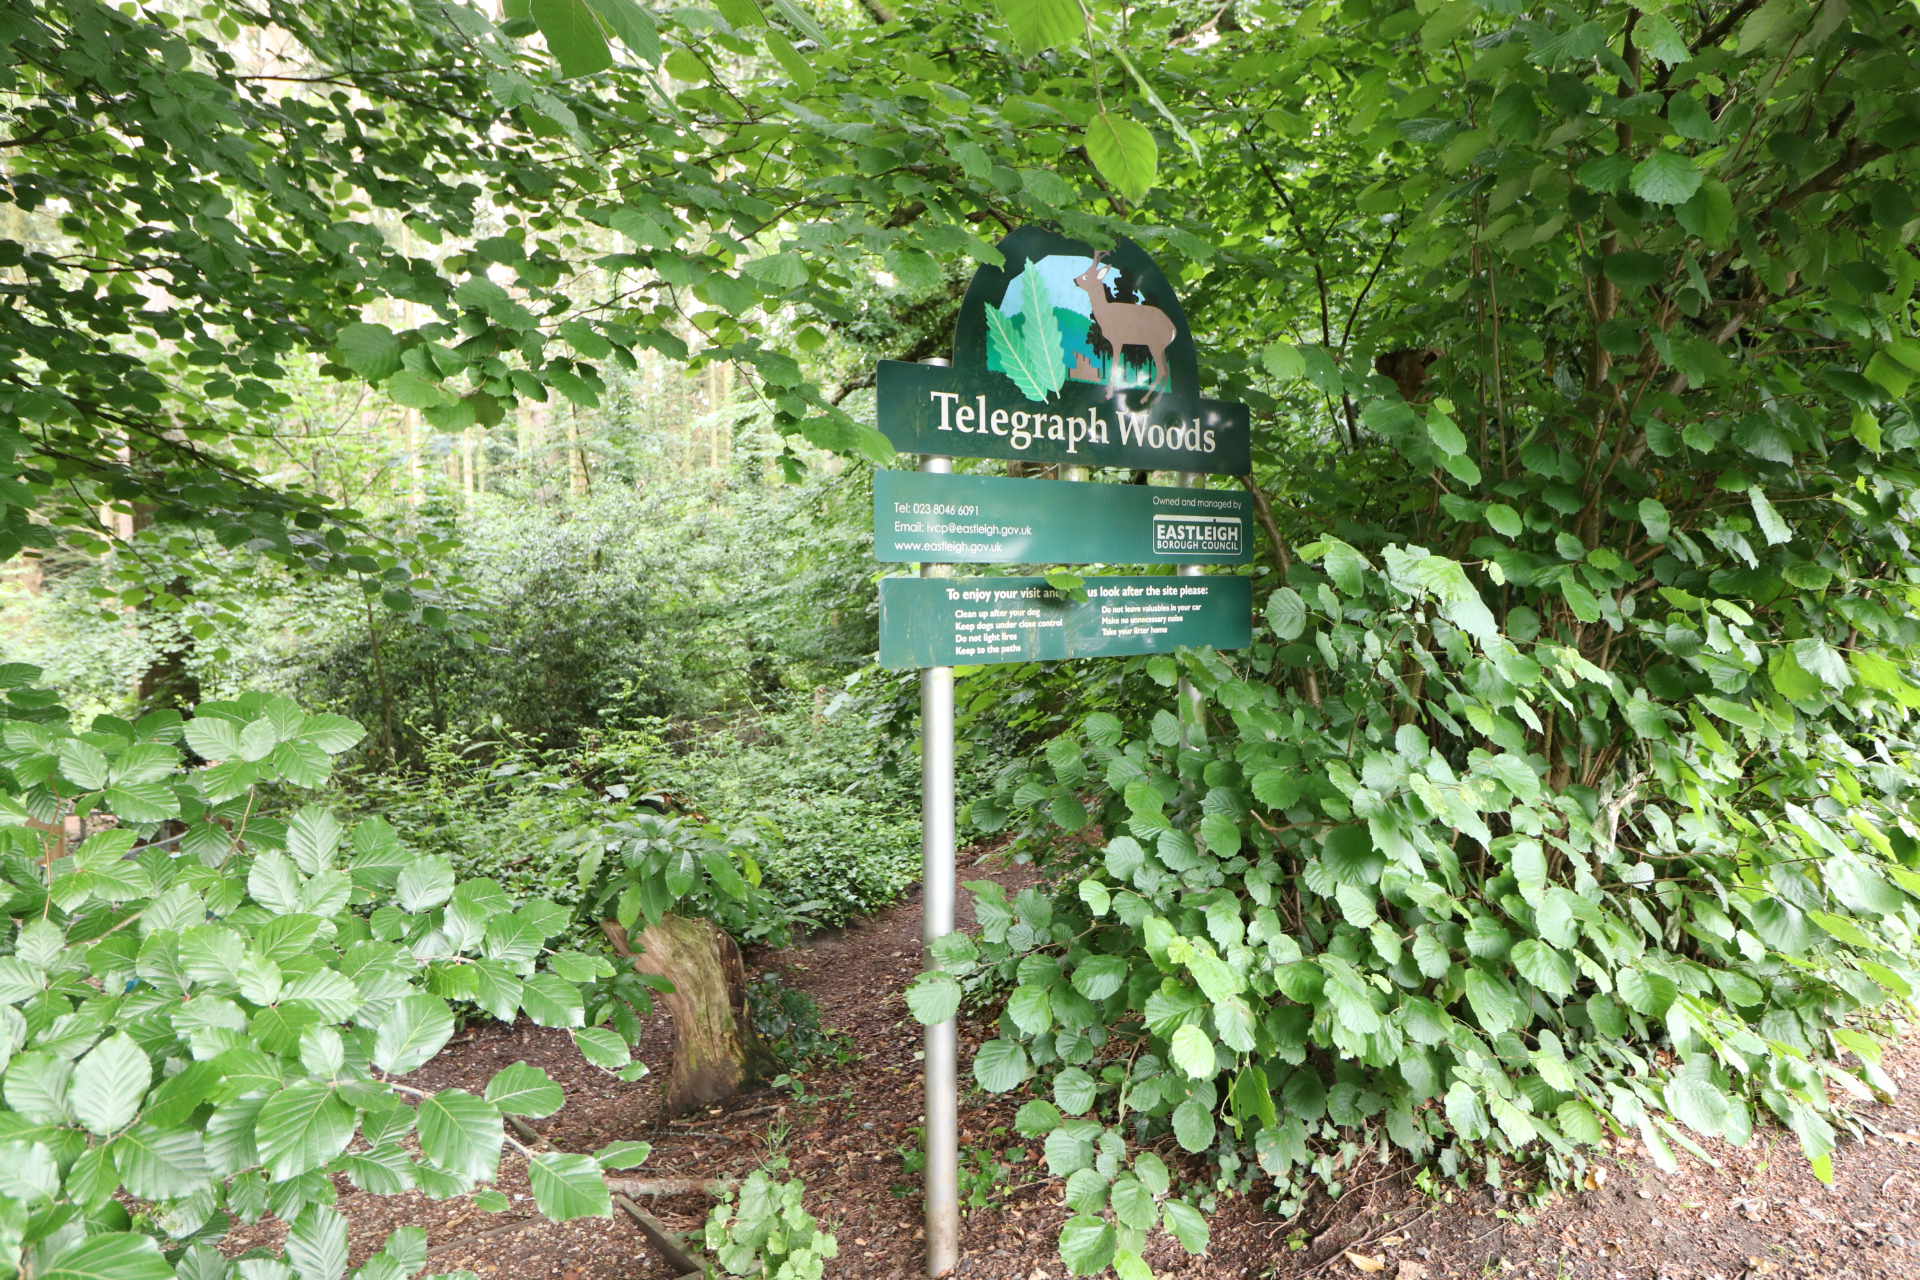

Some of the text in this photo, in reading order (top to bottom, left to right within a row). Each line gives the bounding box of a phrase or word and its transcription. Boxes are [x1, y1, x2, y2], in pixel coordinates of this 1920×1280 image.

[930, 391, 1216, 454] Telegraph Woods
[894, 502, 979, 516] Tel: 023 8046 6091
[1153, 496, 1242, 510] Owned and managed by
[894, 521, 1032, 537] Email: ivcp@eastleigh.gov.uk
[1157, 524, 1238, 541] EASTLEIGH
[894, 540, 1002, 554] www.eastleigh.gov.uk
[1157, 540, 1238, 550] BOROUGH COUNCIL
[946, 588, 960, 600] To
[962, 588, 991, 602] enjoy
[993, 589, 1018, 602] your
[1020, 587, 1041, 599] visit
[1087, 589, 1098, 597] us
[1100, 586, 1120, 597] look
[1122, 586, 1144, 596] after
[1146, 585, 1160, 596] the
[1162, 585, 1178, 596] site
[1180, 584, 1208, 598] please:
[955, 608, 1040, 619] Clean up after your dog
[1101, 605, 1111, 614] Do
[1112, 605, 1124, 613] not
[1125, 604, 1141, 613] leave
[1142, 604, 1169, 612] valuables
[1177, 604, 1191, 613] your
[955, 618, 1062, 632] Keep dogs under close control
[1101, 616, 1119, 625] Make
[1130, 616, 1166, 624] unnecessary
[1167, 614, 1183, 622] noise
[955, 632, 1017, 643] Do not light fires
[1101, 626, 1167, 637] Take your litter home
[955, 644, 1021, 656] Keep to the paths
